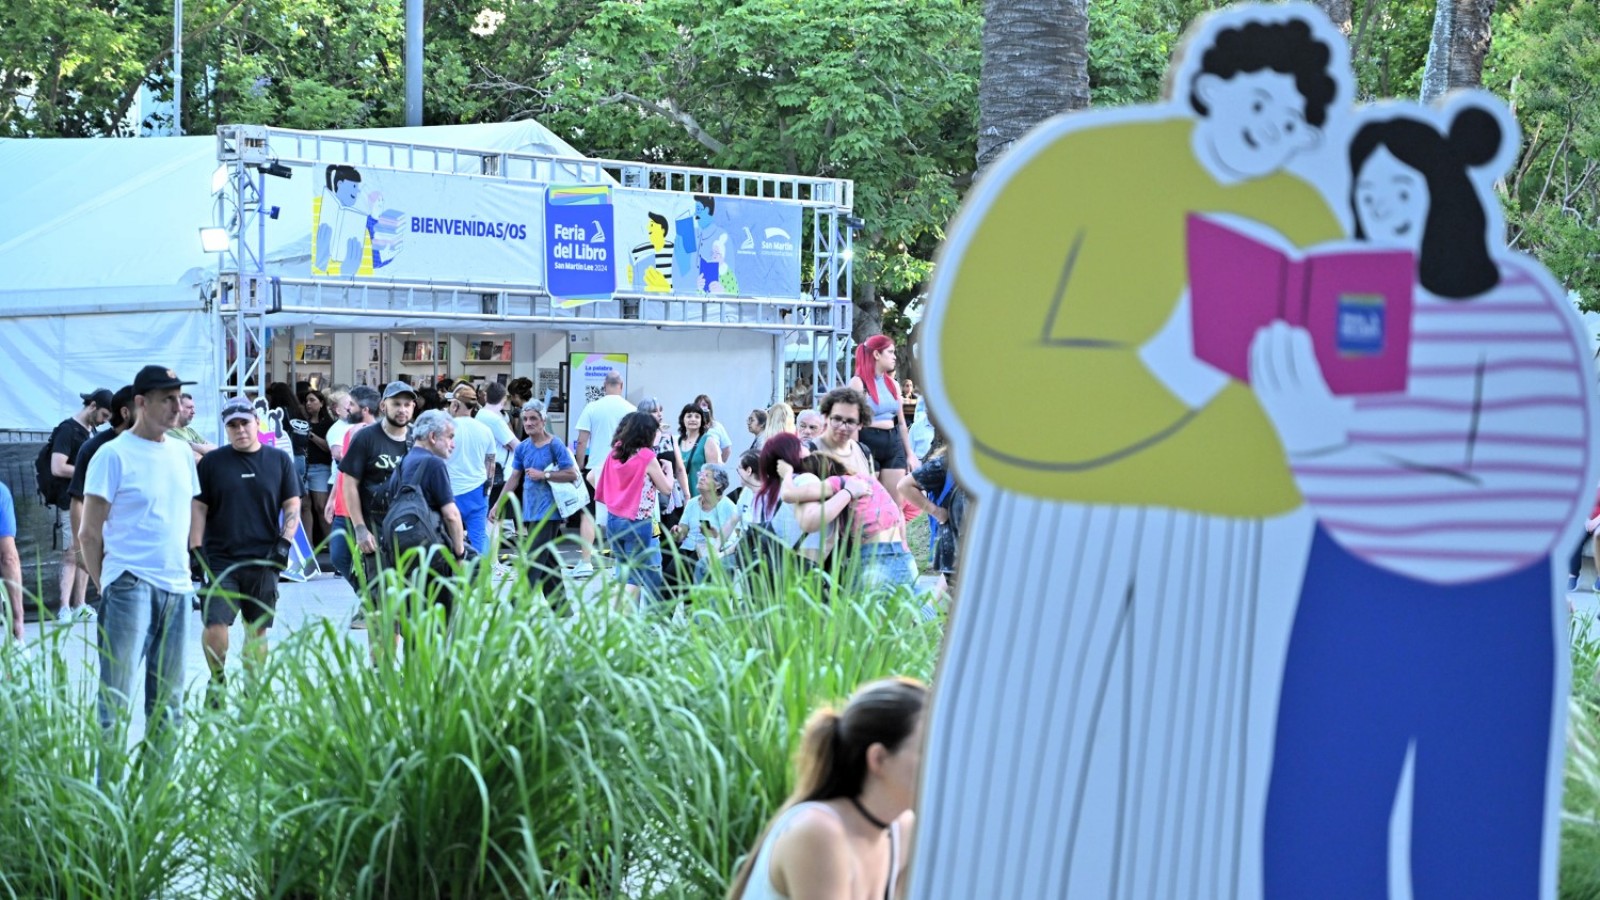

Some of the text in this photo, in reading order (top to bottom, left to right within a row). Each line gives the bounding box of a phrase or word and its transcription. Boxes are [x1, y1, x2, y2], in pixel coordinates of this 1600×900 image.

[411, 216, 527, 241] BIENVENIDAS/OS
[554, 223, 585, 241] Feria
[553, 242, 607, 261] del Libro
[554, 261, 564, 270] San
[584, 263, 594, 271] Lee
[594, 264, 608, 272] 2024
